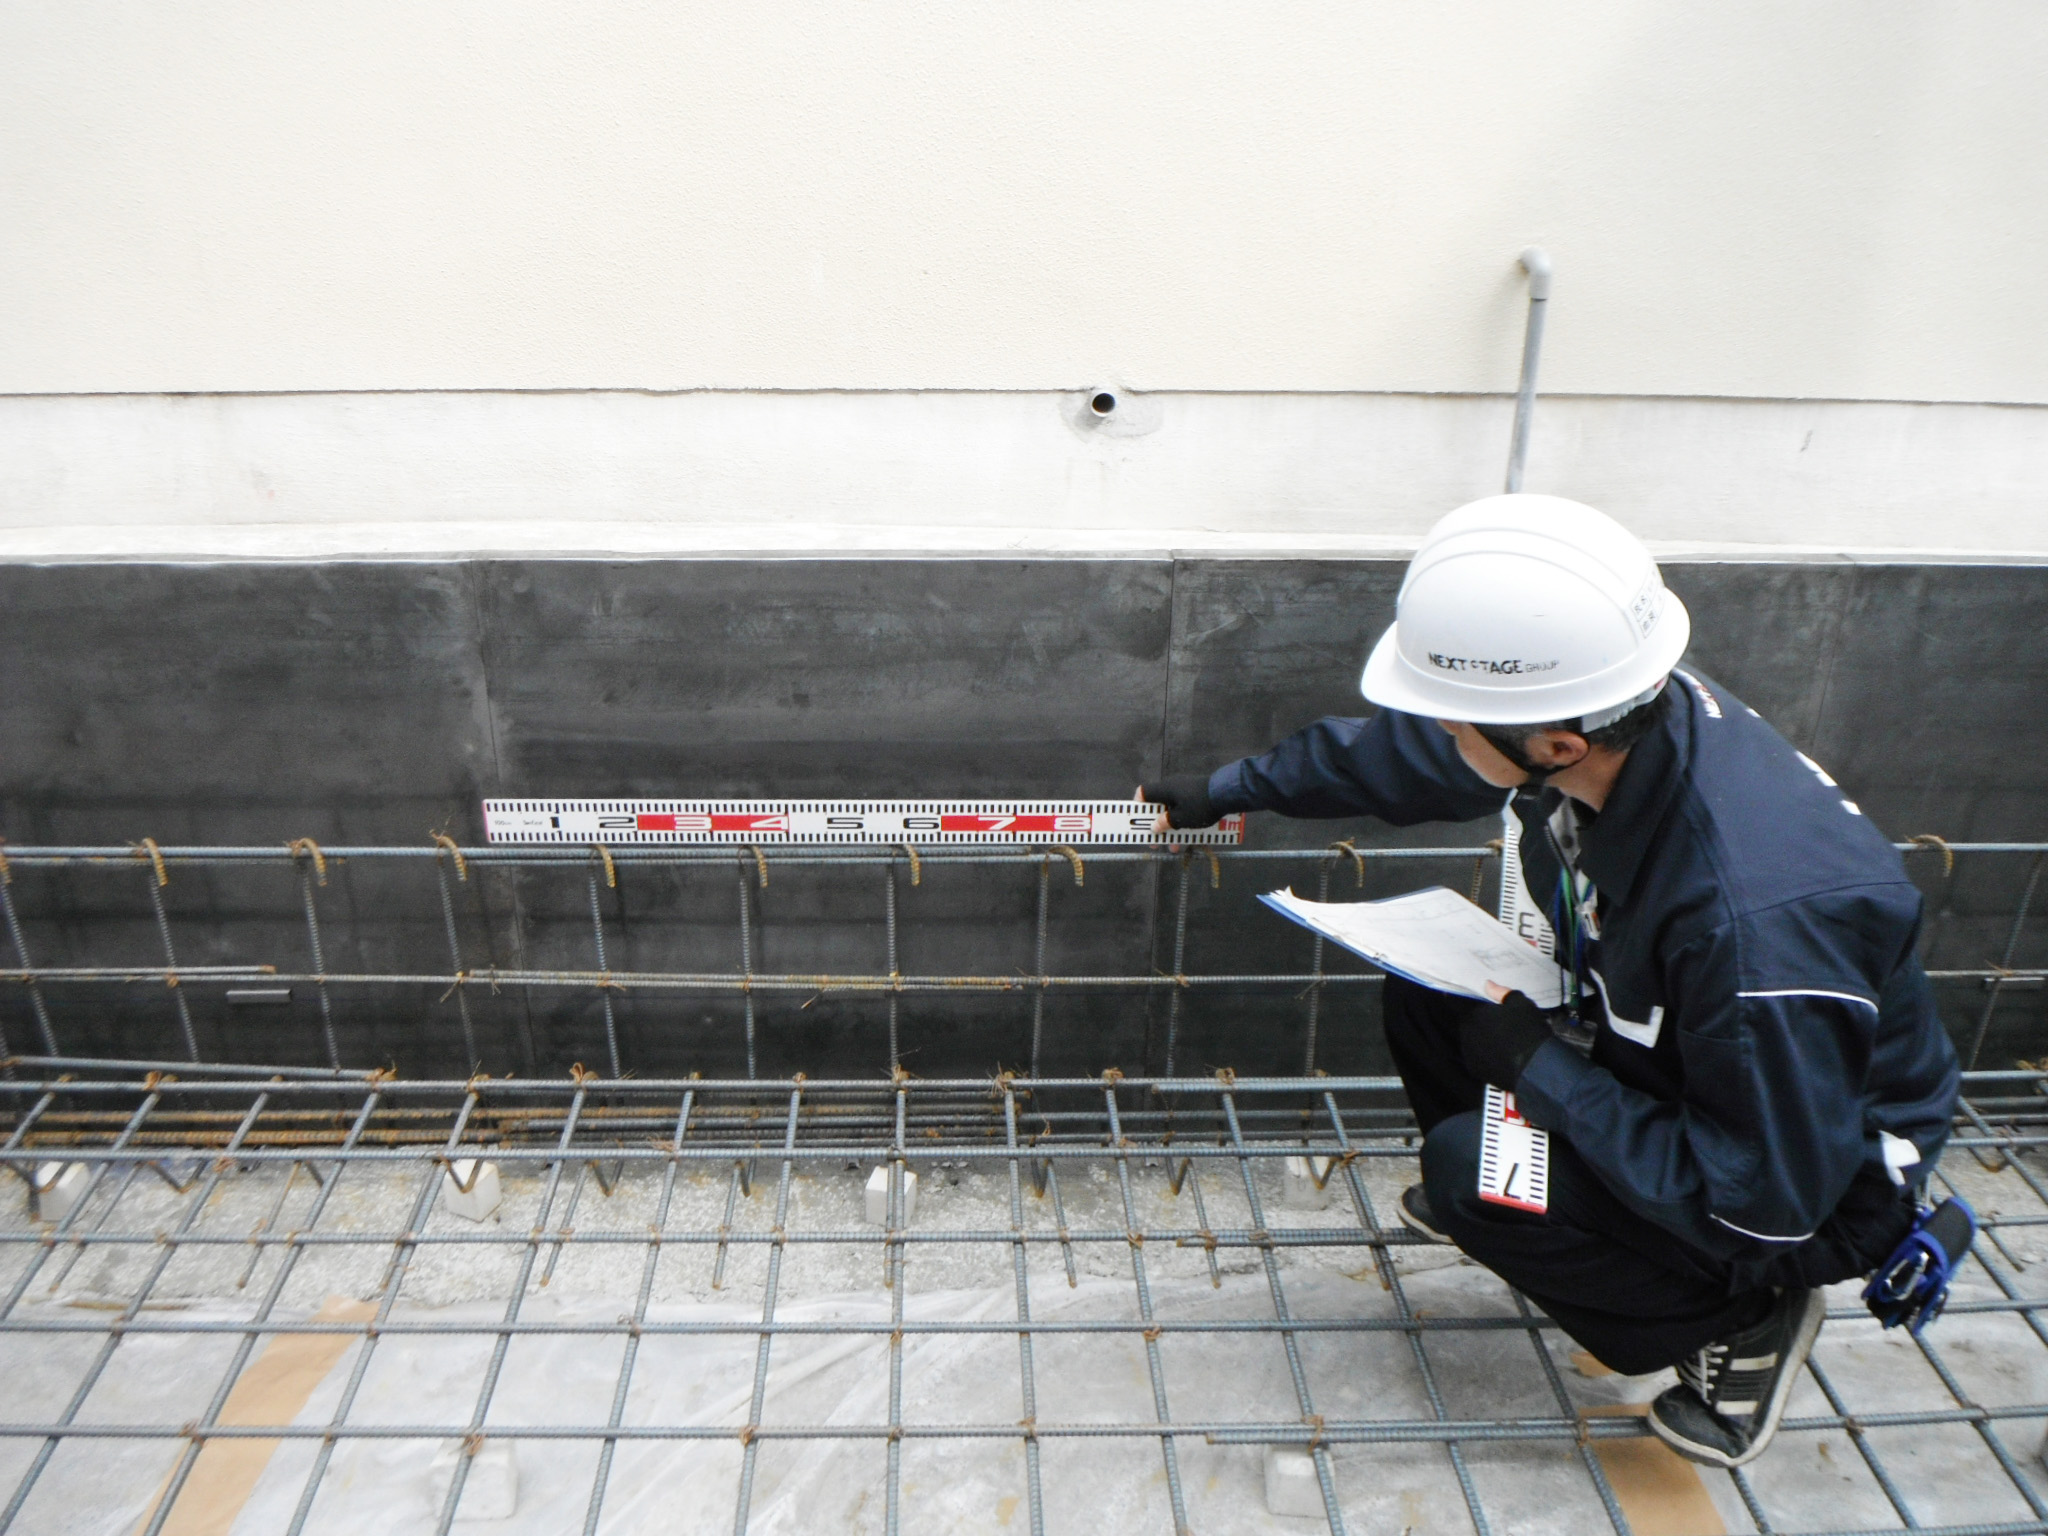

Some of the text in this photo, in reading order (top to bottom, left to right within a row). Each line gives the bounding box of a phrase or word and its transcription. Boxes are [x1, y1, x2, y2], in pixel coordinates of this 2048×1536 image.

[1428, 652, 1468, 671] NEXT
[598, 816, 635, 829] 2
[674, 816, 712, 830] 3
[750, 816, 788, 830] 4
[827, 817, 864, 829] 5
[903, 817, 939, 830] 6
[978, 816, 1016, 830] 7
[1054, 816, 1091, 830] 8
